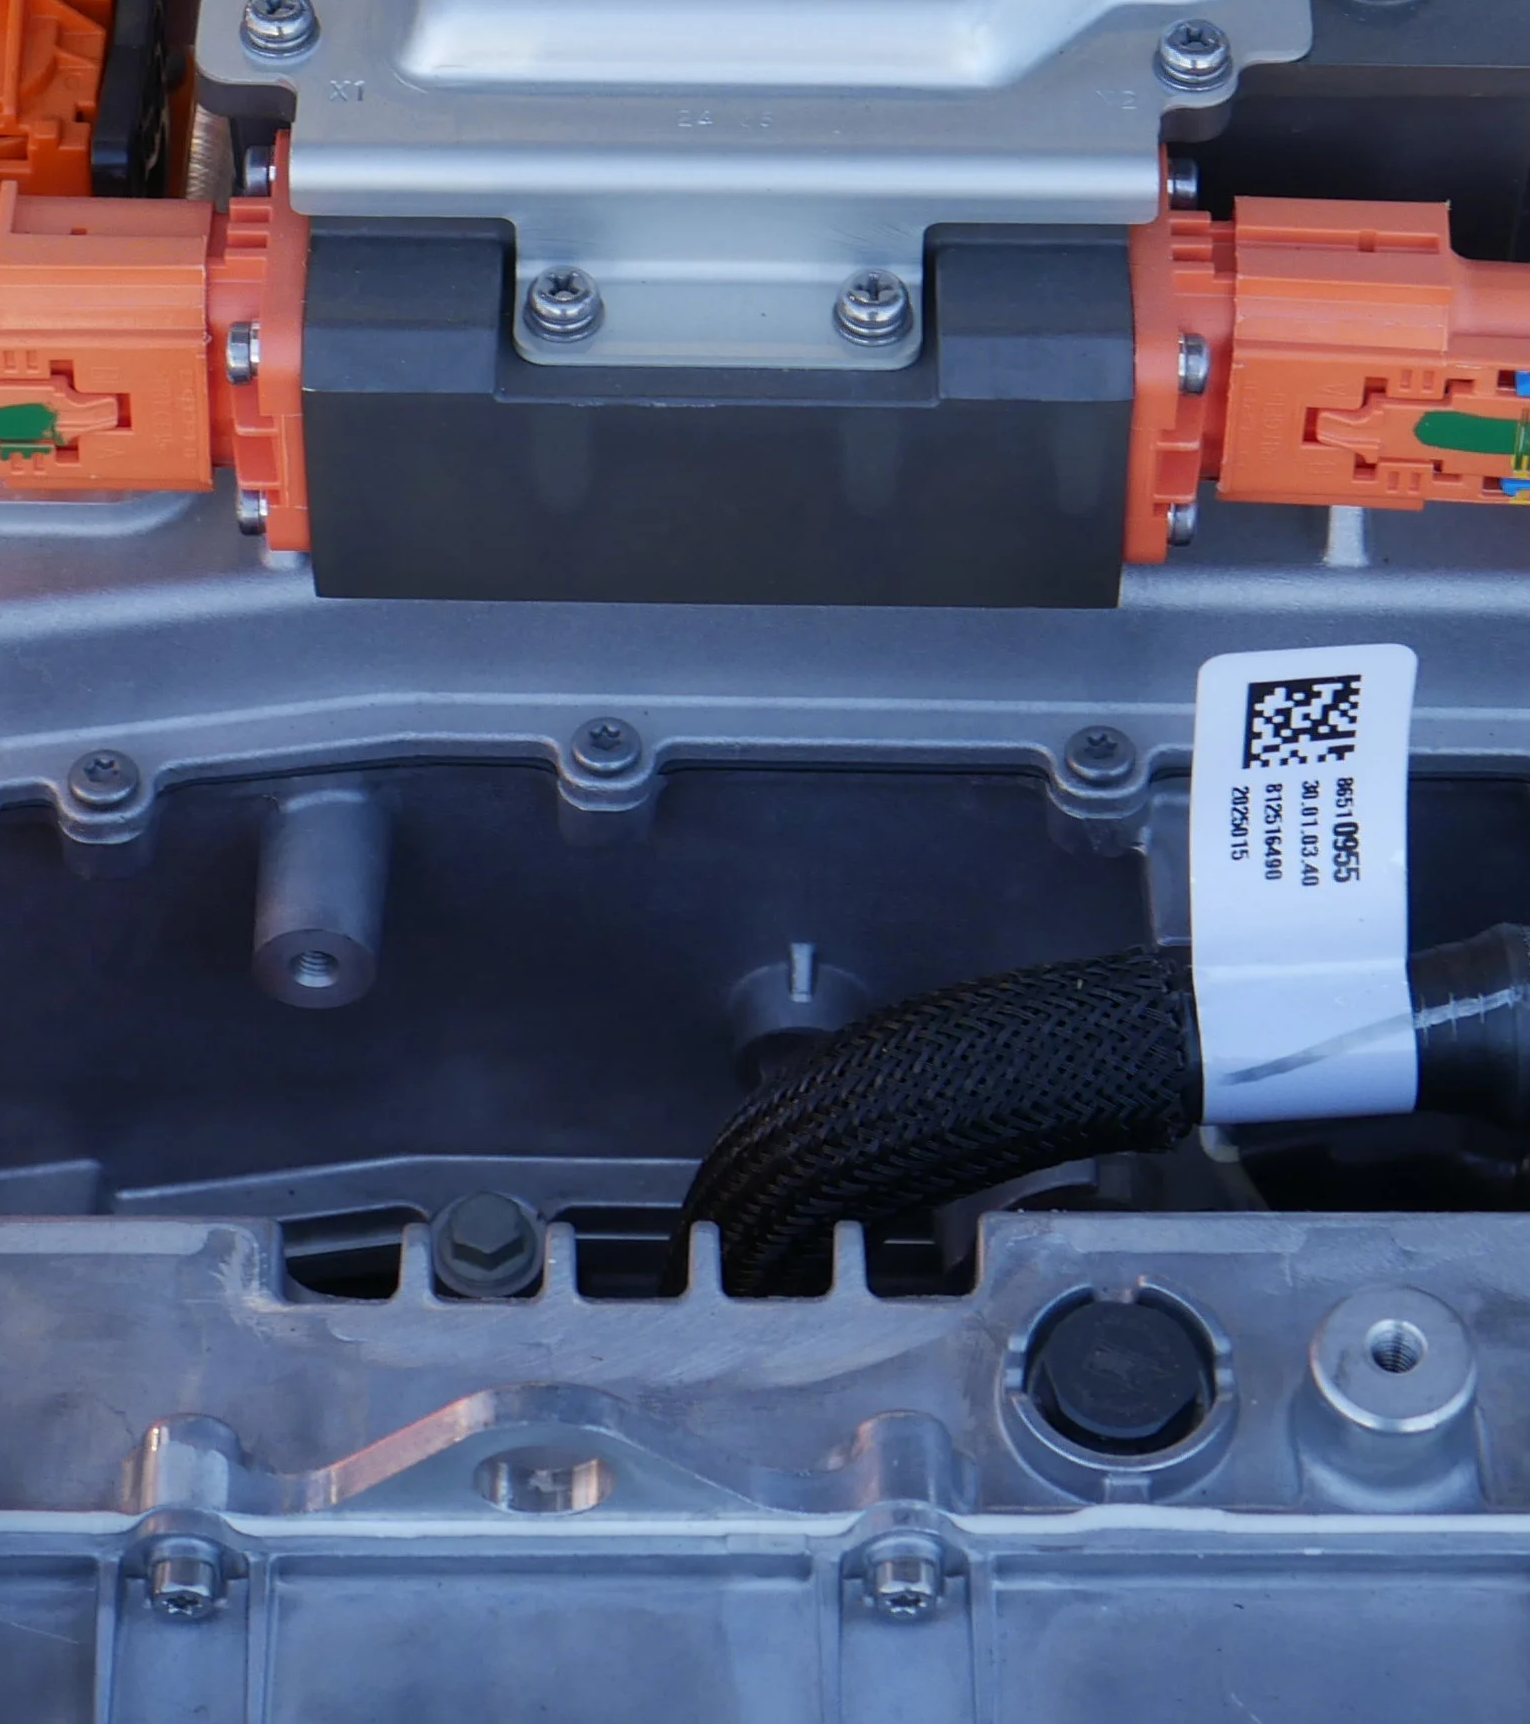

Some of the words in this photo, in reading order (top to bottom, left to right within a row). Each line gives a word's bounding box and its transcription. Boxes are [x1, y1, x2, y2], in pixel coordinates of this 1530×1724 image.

[329, 79, 366, 103] X1
[1230, 786, 1250, 861] 2025015
[1264, 783, 1283, 881] 812516490
[1301, 780, 1320, 887] 30.01.03.40
